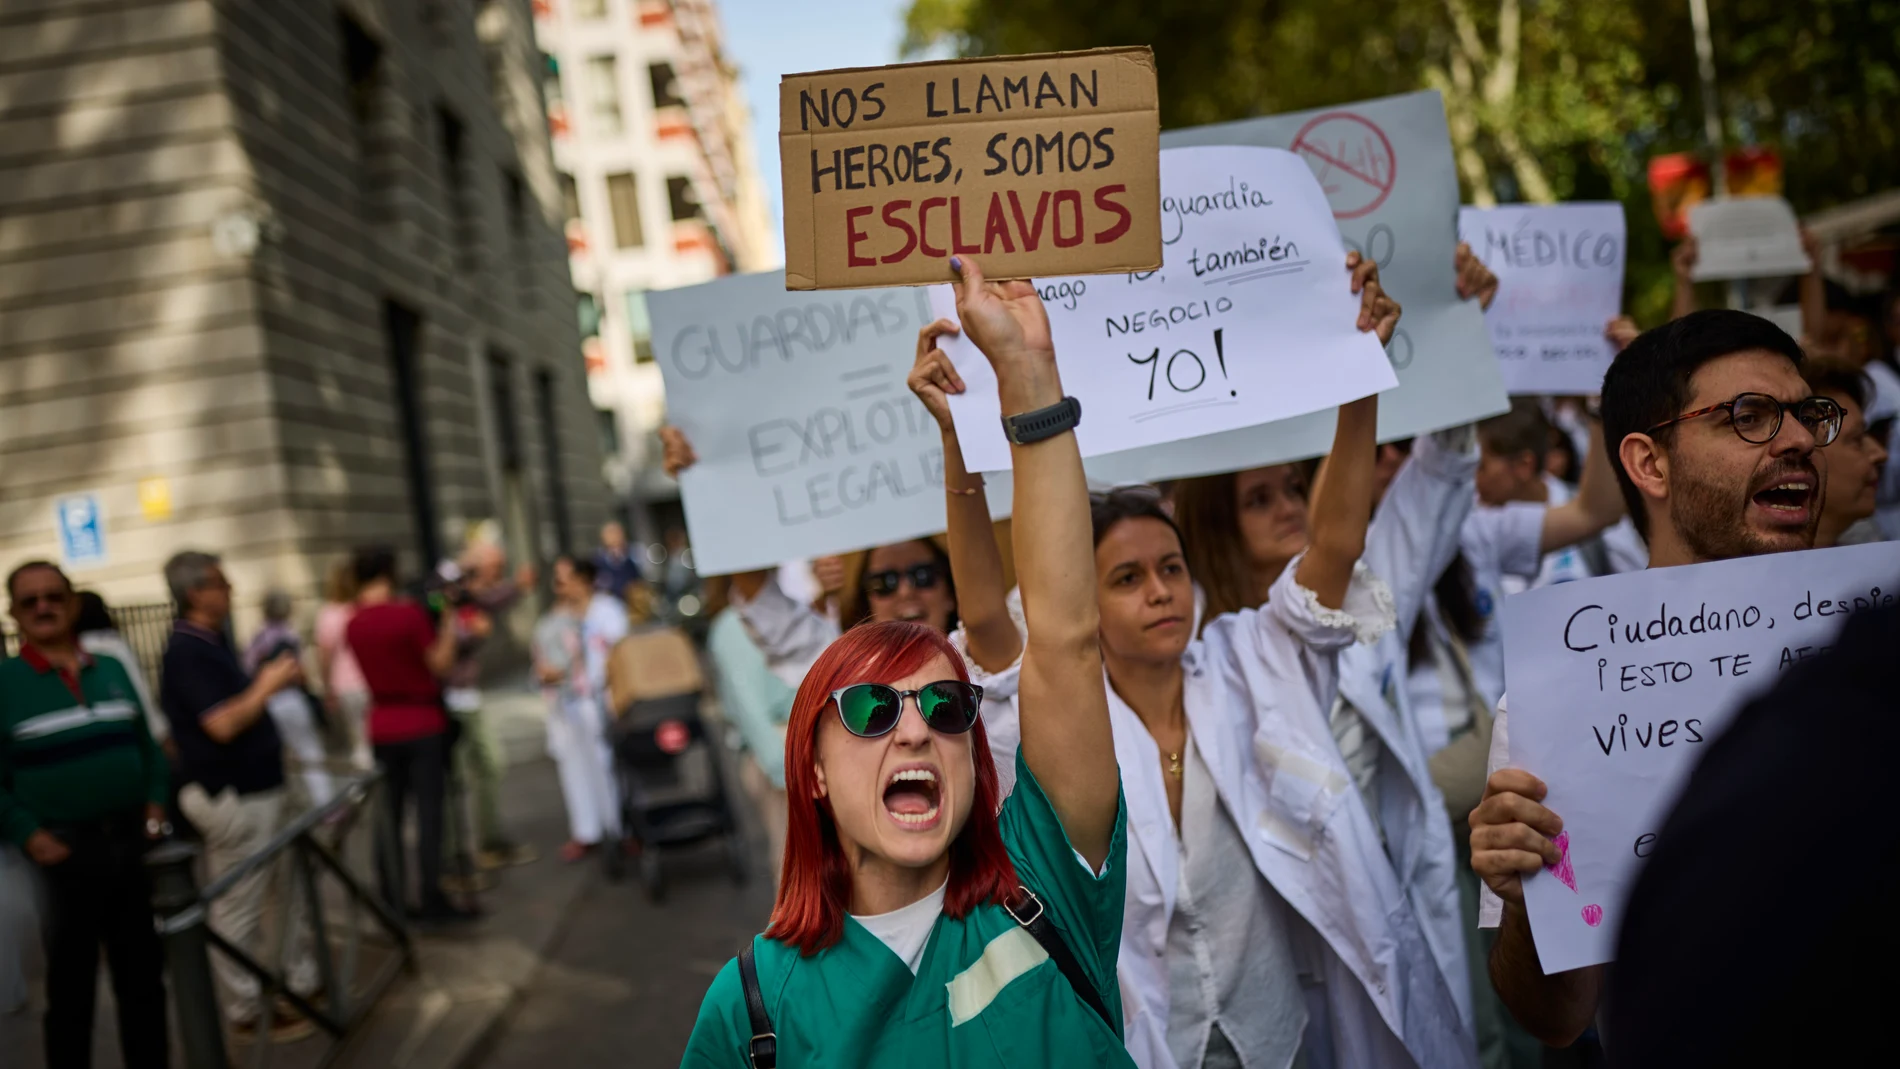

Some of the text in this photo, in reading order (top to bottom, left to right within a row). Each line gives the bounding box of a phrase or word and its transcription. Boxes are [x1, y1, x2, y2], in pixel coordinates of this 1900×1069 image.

[799, 69, 1099, 131] NOS LLAMAN
[811, 127, 1115, 195] HEROES, SOMOS
[845, 184, 1132, 268] ESCLAVOS
[1161, 176, 1274, 245] guardia
[1187, 235, 1300, 278] también
[1484, 214, 1619, 270] MÉDICO
[671, 291, 909, 380] GUARDIAS
[1106, 296, 1234, 338] NEGOCIO
[1127, 328, 1239, 401] YO!
[1563, 602, 1776, 652] Ciudadano,
[1709, 654, 1753, 678] TE
[1592, 714, 1704, 757] vives
